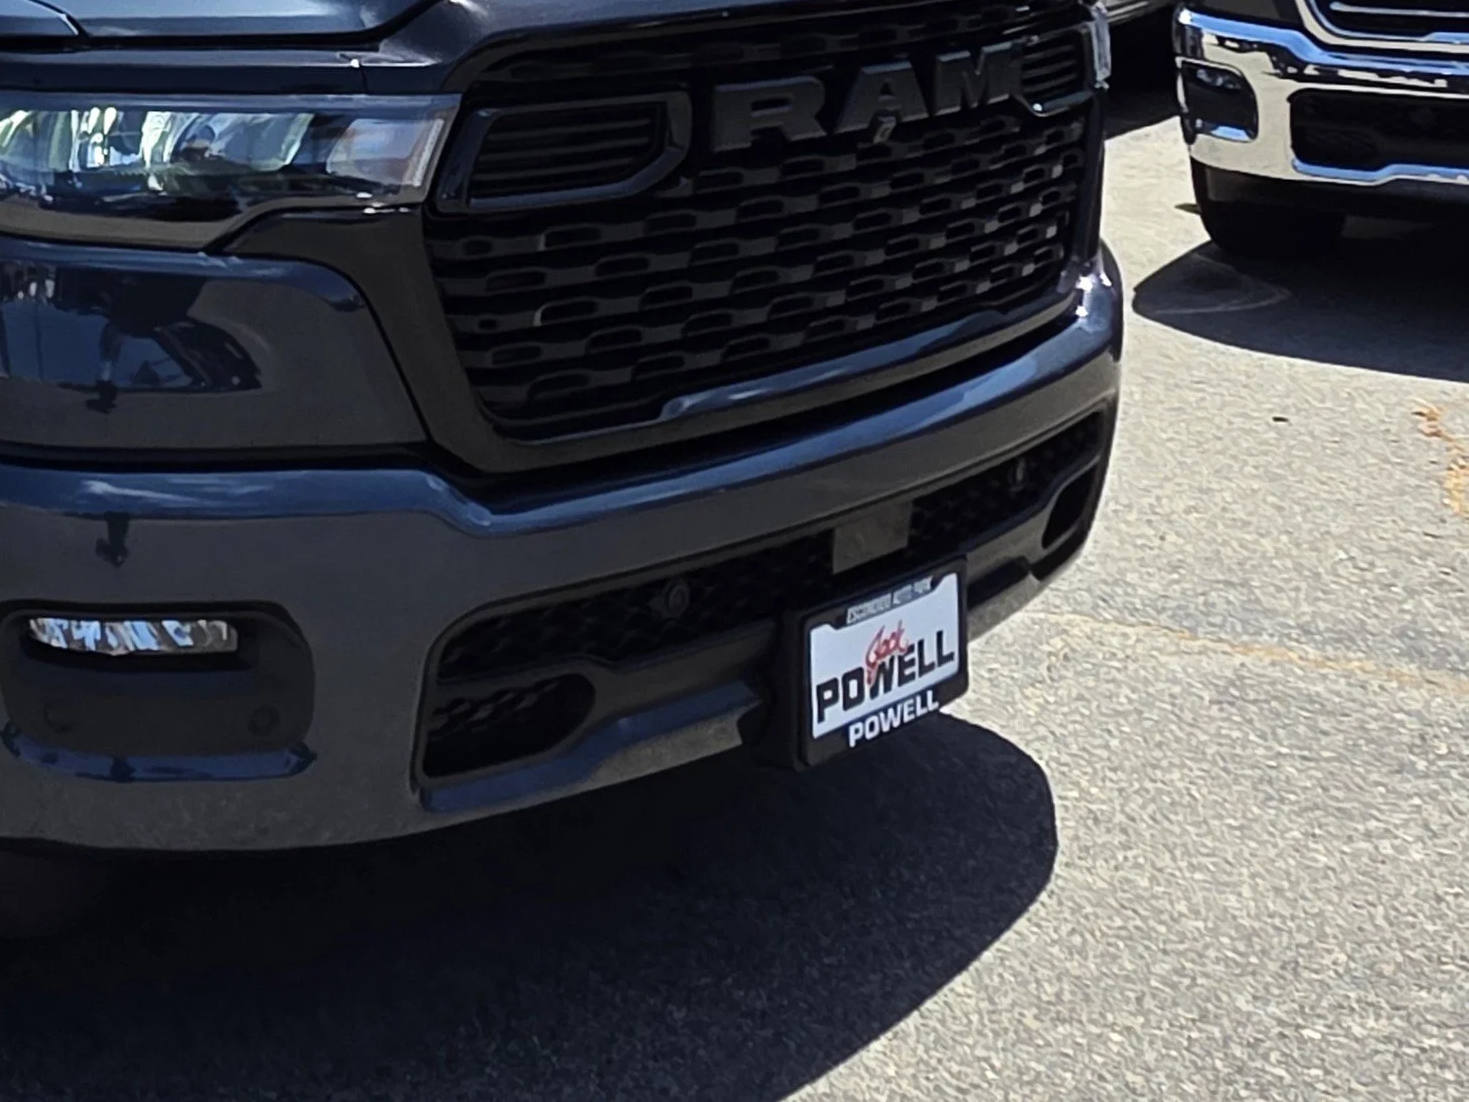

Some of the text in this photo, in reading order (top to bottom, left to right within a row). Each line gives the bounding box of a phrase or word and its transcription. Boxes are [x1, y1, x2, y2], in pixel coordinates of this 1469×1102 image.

[713, 40, 1026, 152] RAM
[816, 629, 956, 725] POWELL
[848, 689, 940, 748] POWELL
